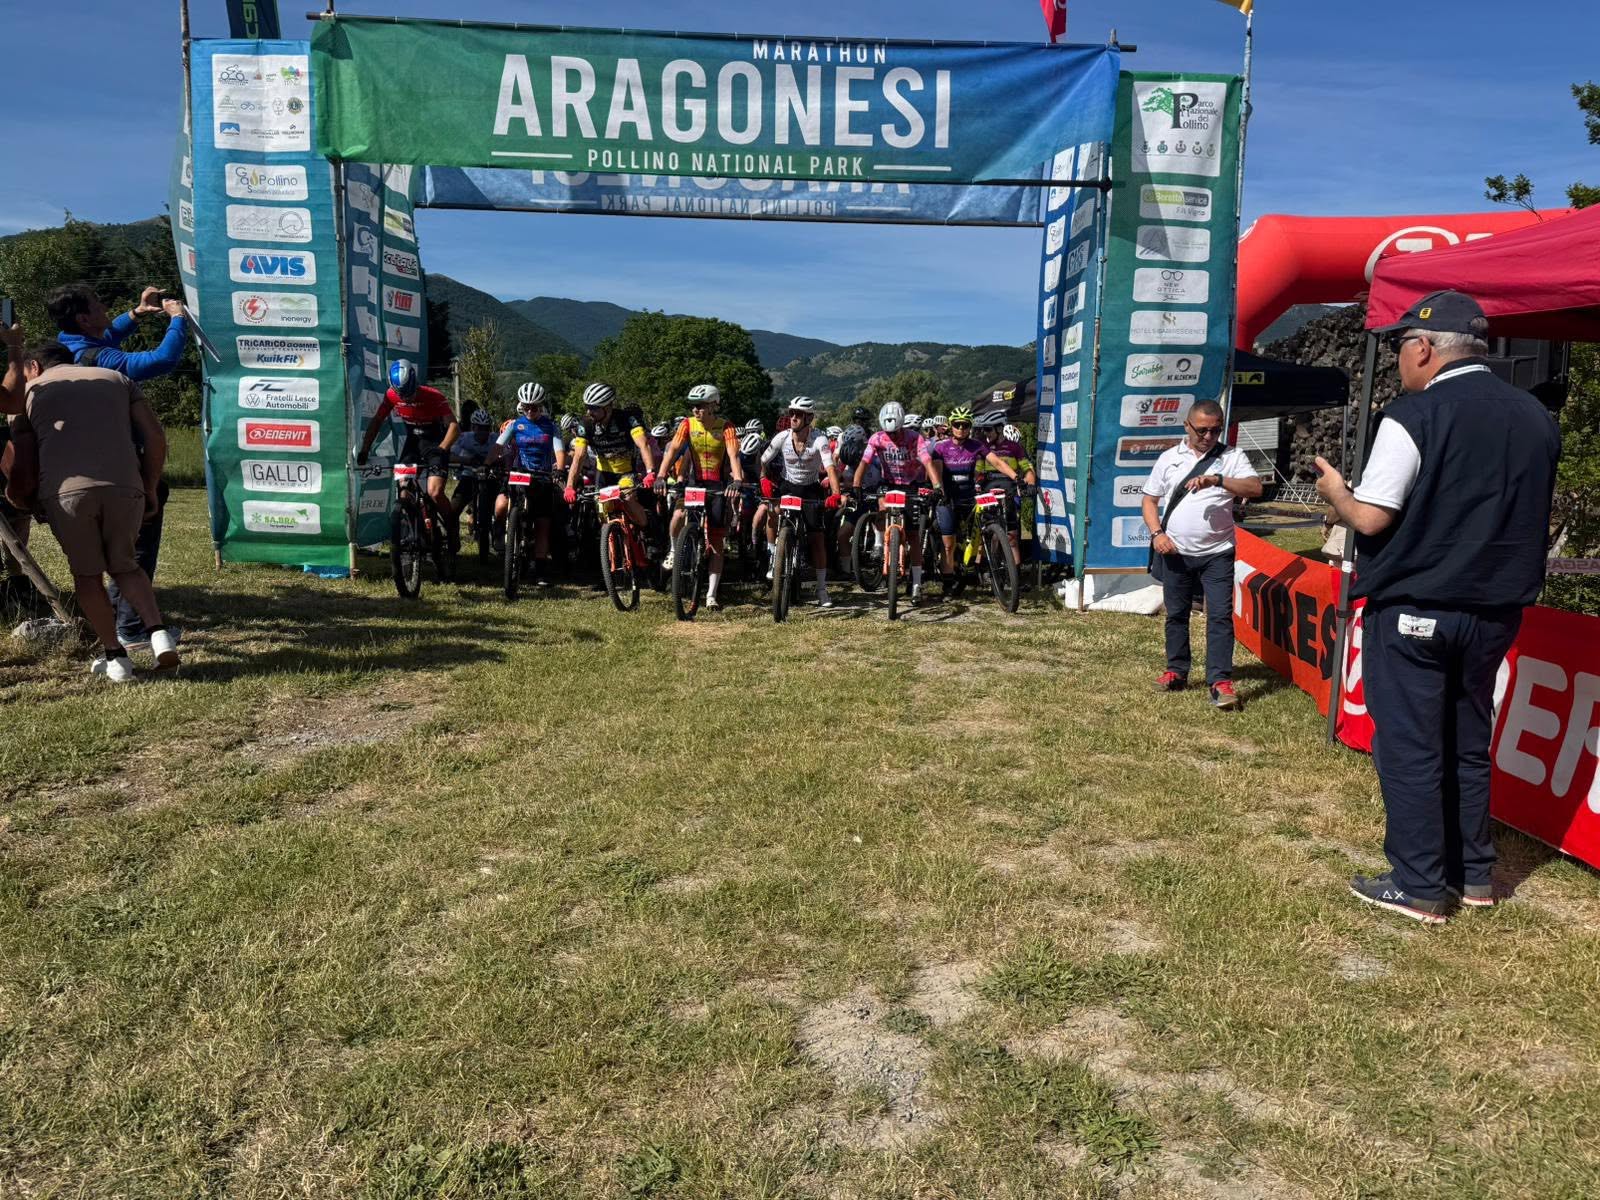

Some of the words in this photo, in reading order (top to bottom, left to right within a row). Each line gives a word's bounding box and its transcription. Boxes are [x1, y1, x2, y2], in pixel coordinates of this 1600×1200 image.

[752, 39, 887, 64] MARATHON
[492, 53, 951, 149] ARAGONESI
[586, 149, 680, 171] POLLINO
[691, 153, 797, 176] NATIONAL
[810, 157, 863, 177] PARK
[240, 255, 306, 277] AVIS
[265, 393, 294, 402] Fratelli
[295, 394, 316, 403] Lesce
[265, 401, 309, 410] Automobili
[265, 429, 307, 441] ENERVIT
[252, 464, 308, 483] GALLO
[1247, 572, 1337, 681] TIRES
